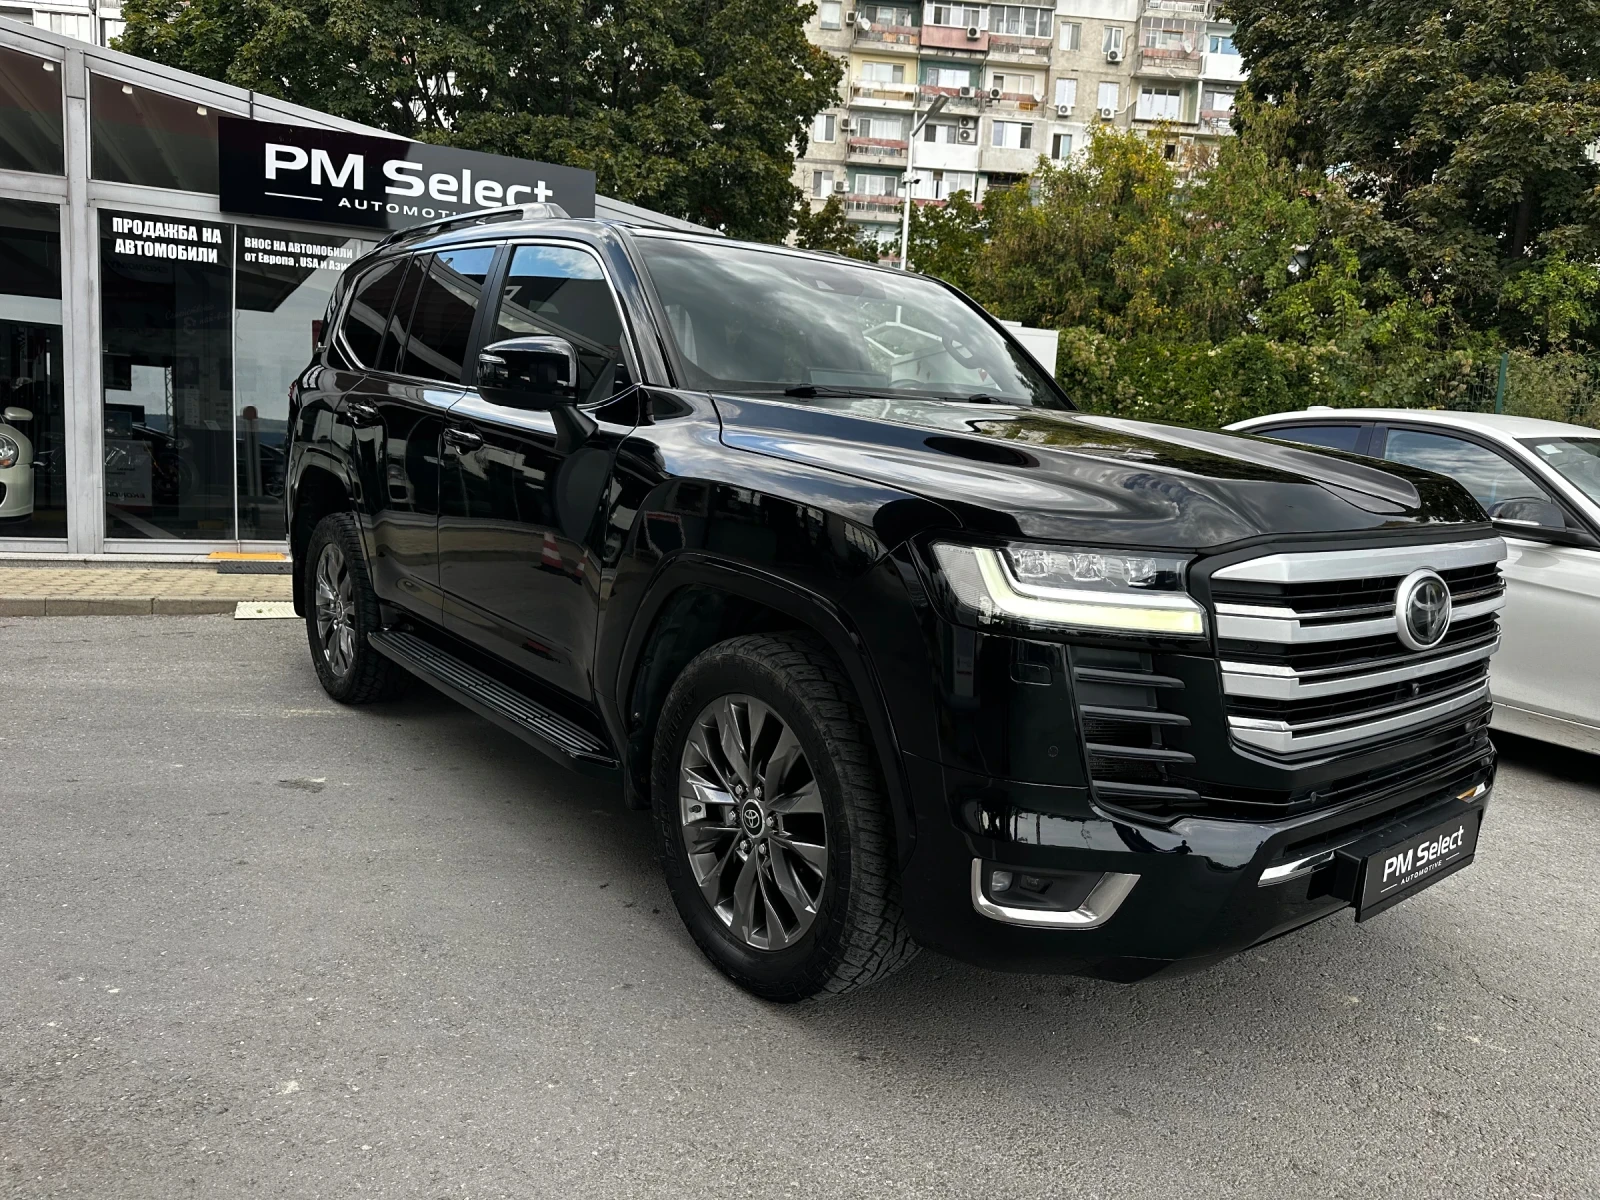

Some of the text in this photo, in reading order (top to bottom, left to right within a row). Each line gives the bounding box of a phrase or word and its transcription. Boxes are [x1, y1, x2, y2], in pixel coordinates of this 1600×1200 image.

[265, 142, 553, 207] PM Select
[338, 197, 463, 219] AUTOMOT
[112, 216, 222, 244] ПРОДАЖБА НА
[114, 238, 218, 264] АВТОМОБИЛИ
[244, 237, 353, 259] ВНОС НА АВТОМОБИЛИ
[244, 252, 257, 262] от
[299, 257, 319, 269] USA
[320, 261, 327, 270] и
[328, 259, 351, 271] Ази
[1382, 825, 1465, 883] PM Select
[1400, 860, 1442, 885] AUTOMOTIVE
